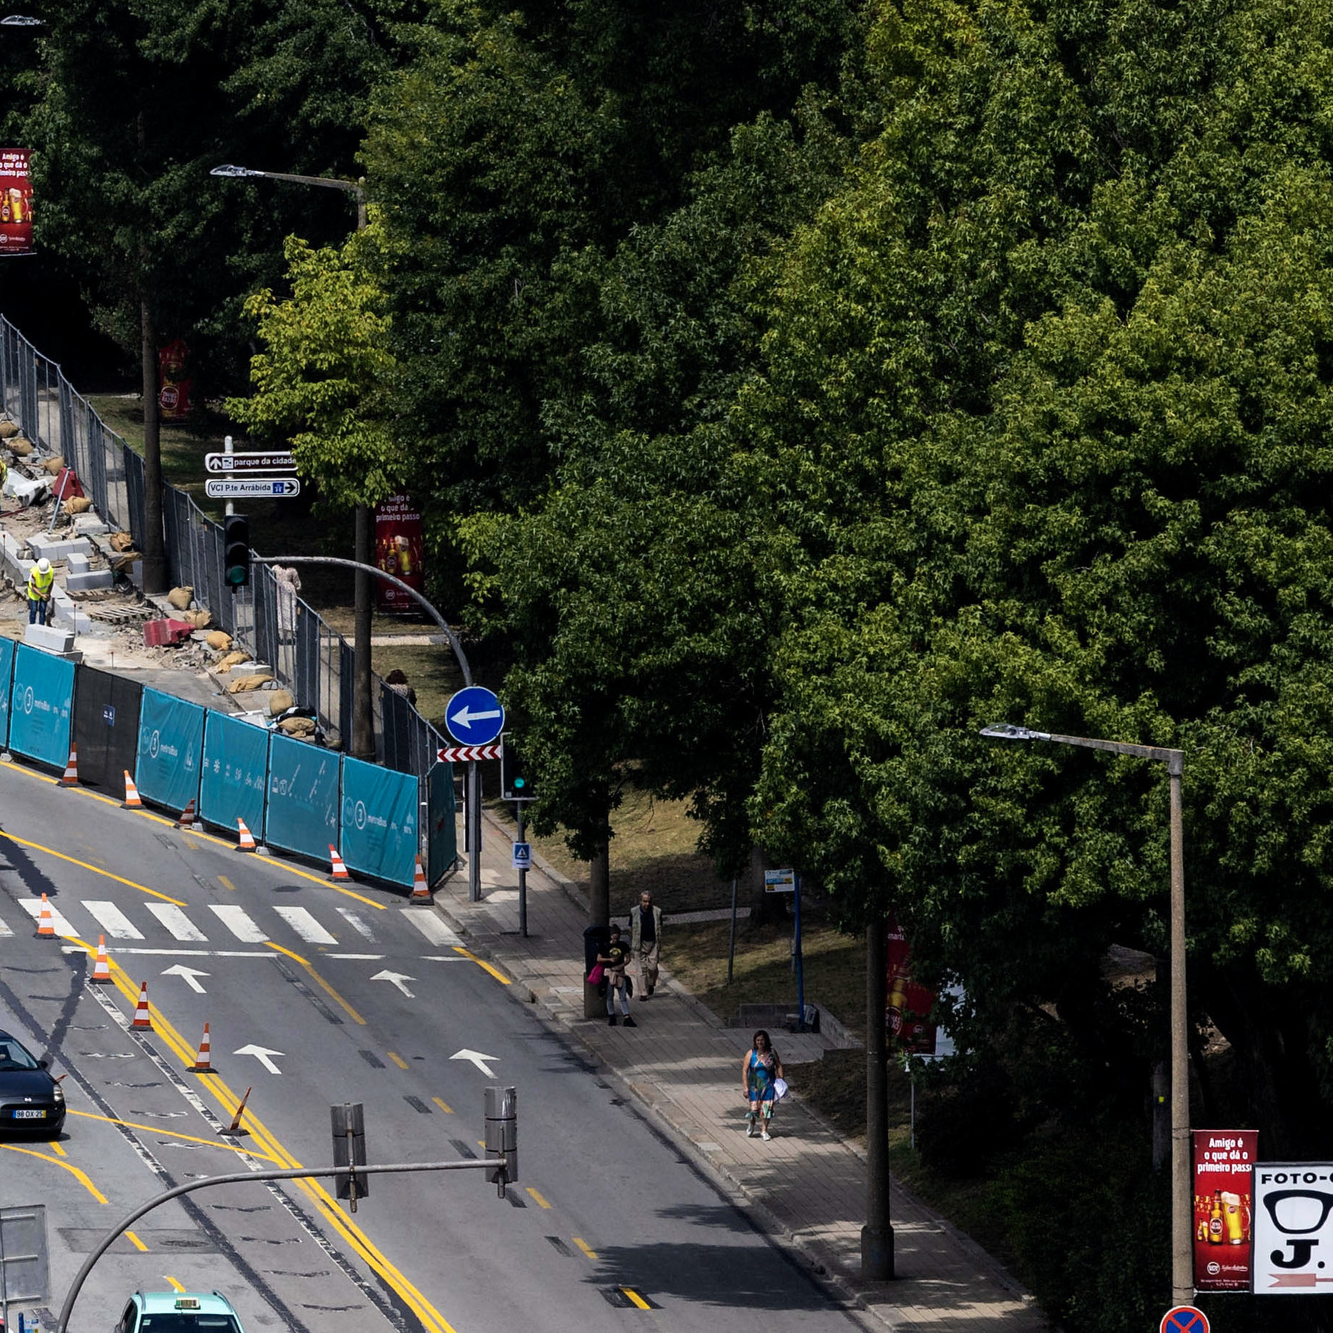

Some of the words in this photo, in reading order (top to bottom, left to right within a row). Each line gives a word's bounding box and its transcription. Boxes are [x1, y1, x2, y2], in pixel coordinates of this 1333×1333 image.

[2, 153, 19, 162] Amigo
[3, 162, 14, 170] que
[234, 459, 260, 467] parque
[210, 484, 224, 492] VCI
[225, 484, 238, 492] P.te
[239, 483, 271, 491] Arrábida
[386, 506, 399, 514] que
[376, 513, 401, 523] primeiro
[402, 513, 421, 522] passo
[1209, 1137, 1236, 1151] Amigo
[1237, 1137, 1244, 1148] é
[1204, 1151, 1210, 1160] o
[1211, 1151, 1228, 1162] que
[1229, 1149, 1241, 1160] dá
[1242, 1151, 1248, 1160] o
[1197, 1162, 1231, 1175] primeiro
[1270, 1239, 1326, 1269] J.
